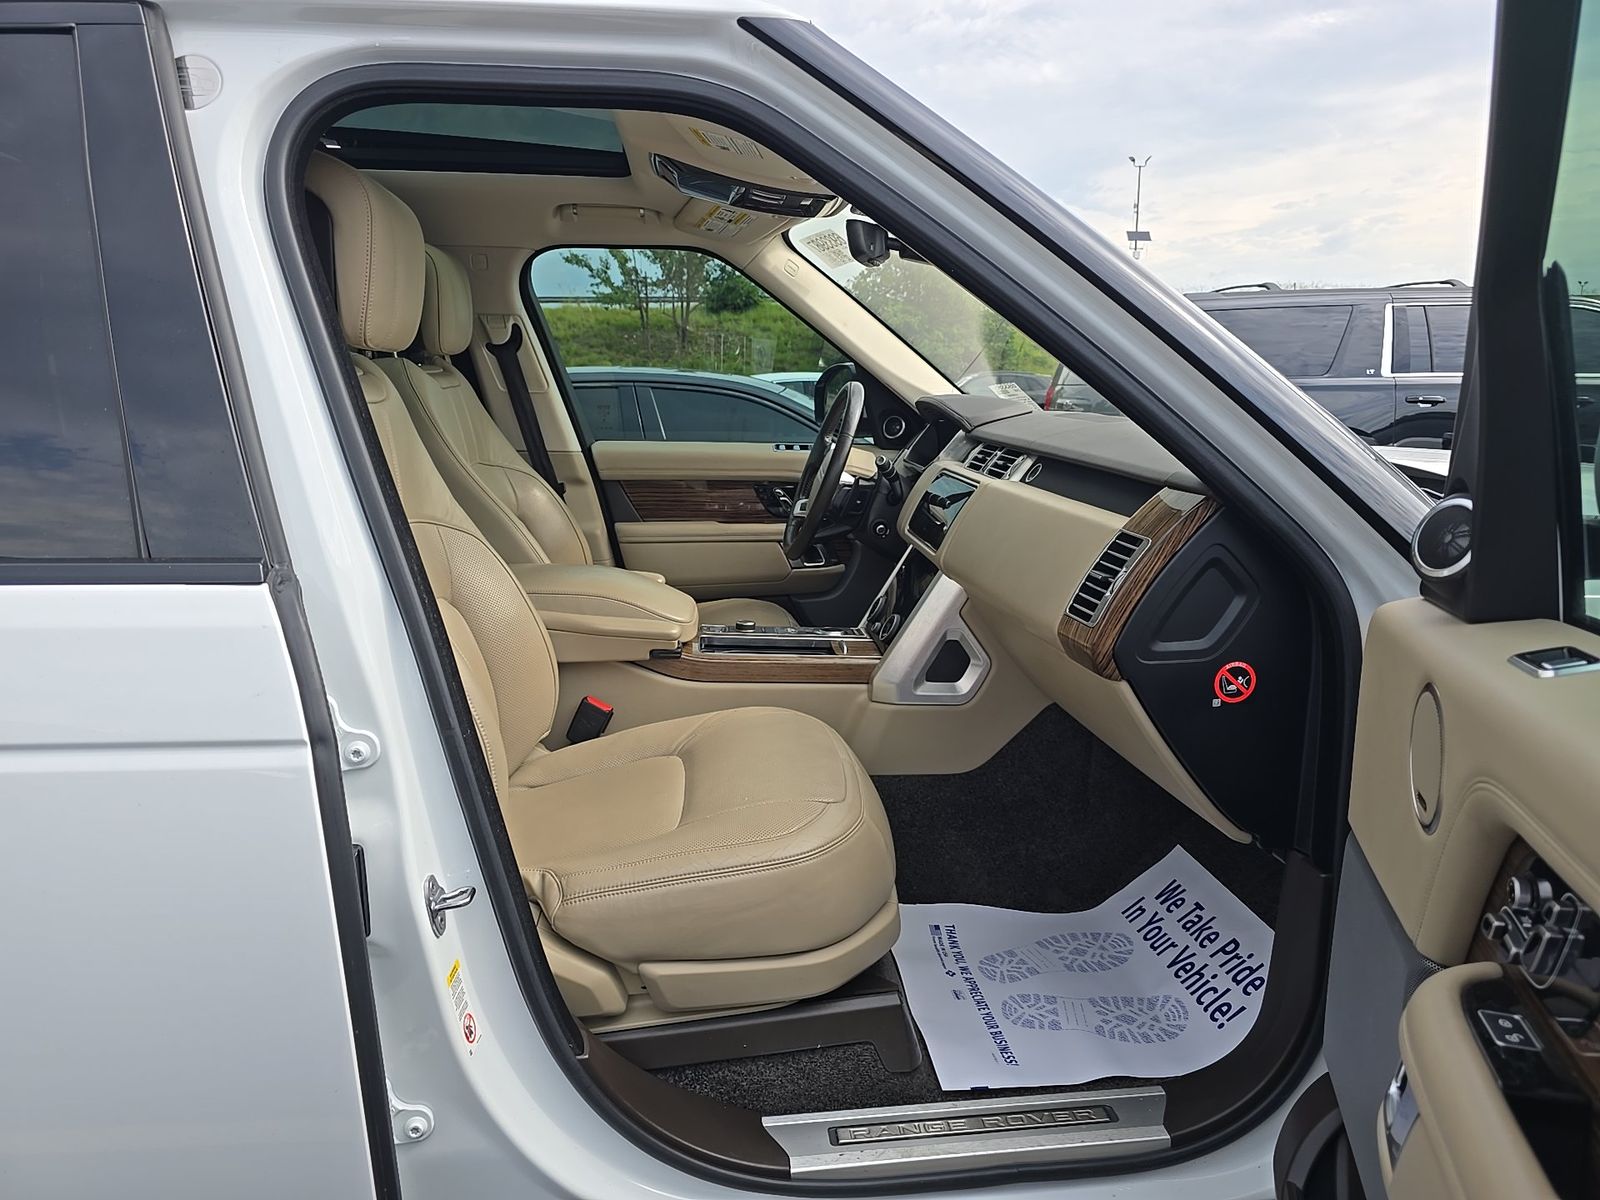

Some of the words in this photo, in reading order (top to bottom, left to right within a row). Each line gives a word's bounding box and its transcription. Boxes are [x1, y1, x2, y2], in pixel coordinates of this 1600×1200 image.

[944, 924, 961, 950] THANK
[1154, 878, 1187, 914] We
[1176, 901, 1220, 949] Take
[1208, 937, 1266, 997] Pride
[952, 947, 967, 965] YOU,
[958, 965, 973, 977] WE
[1121, 896, 1147, 924] In
[1136, 910, 1179, 957] Your
[1166, 944, 1247, 1030] Vehicle!
[962, 973, 991, 1012] APPRECIATE
[979, 1007, 1000, 1031] YOUR
[989, 1029, 1020, 1067] BUSINESS!
[849, 1119, 968, 1140] RANGE
[982, 1109, 1098, 1128] ROVER
